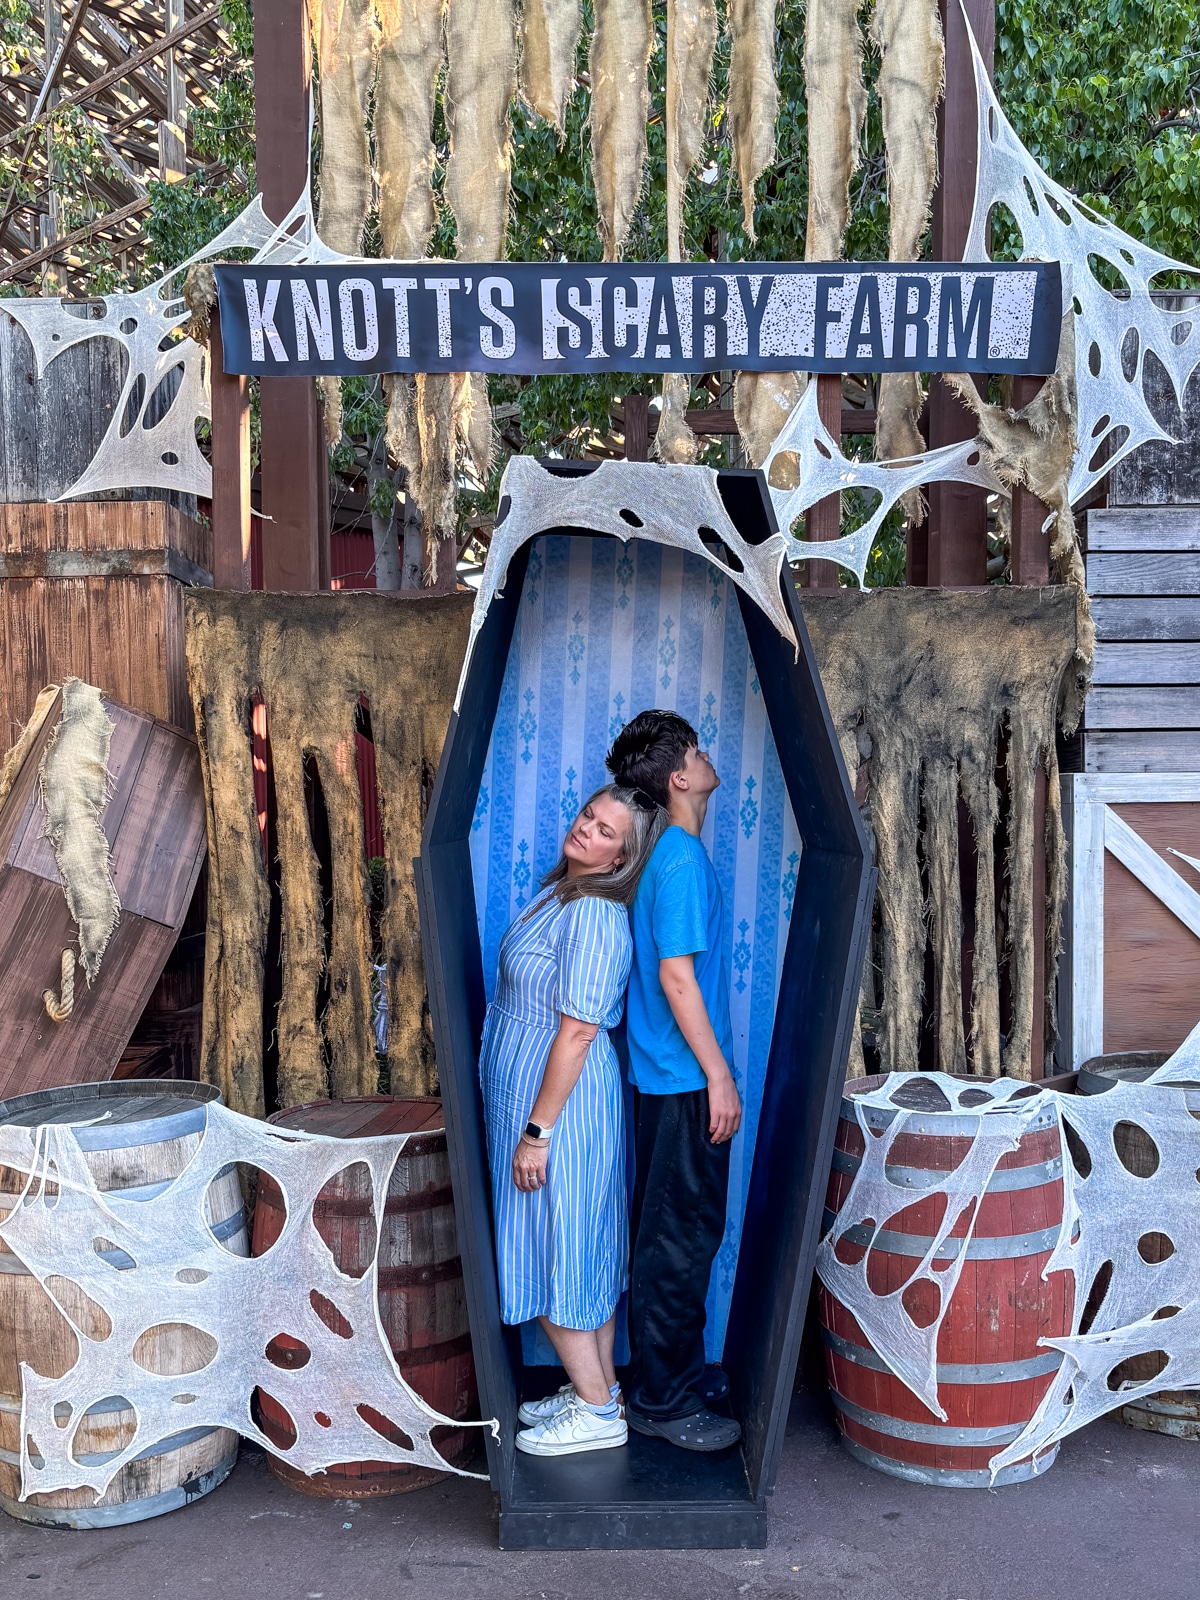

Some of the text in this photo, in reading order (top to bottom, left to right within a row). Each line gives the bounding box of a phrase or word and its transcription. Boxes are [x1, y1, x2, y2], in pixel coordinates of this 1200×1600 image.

[242, 275, 996, 362] KNOTT'S SCARY FARM
